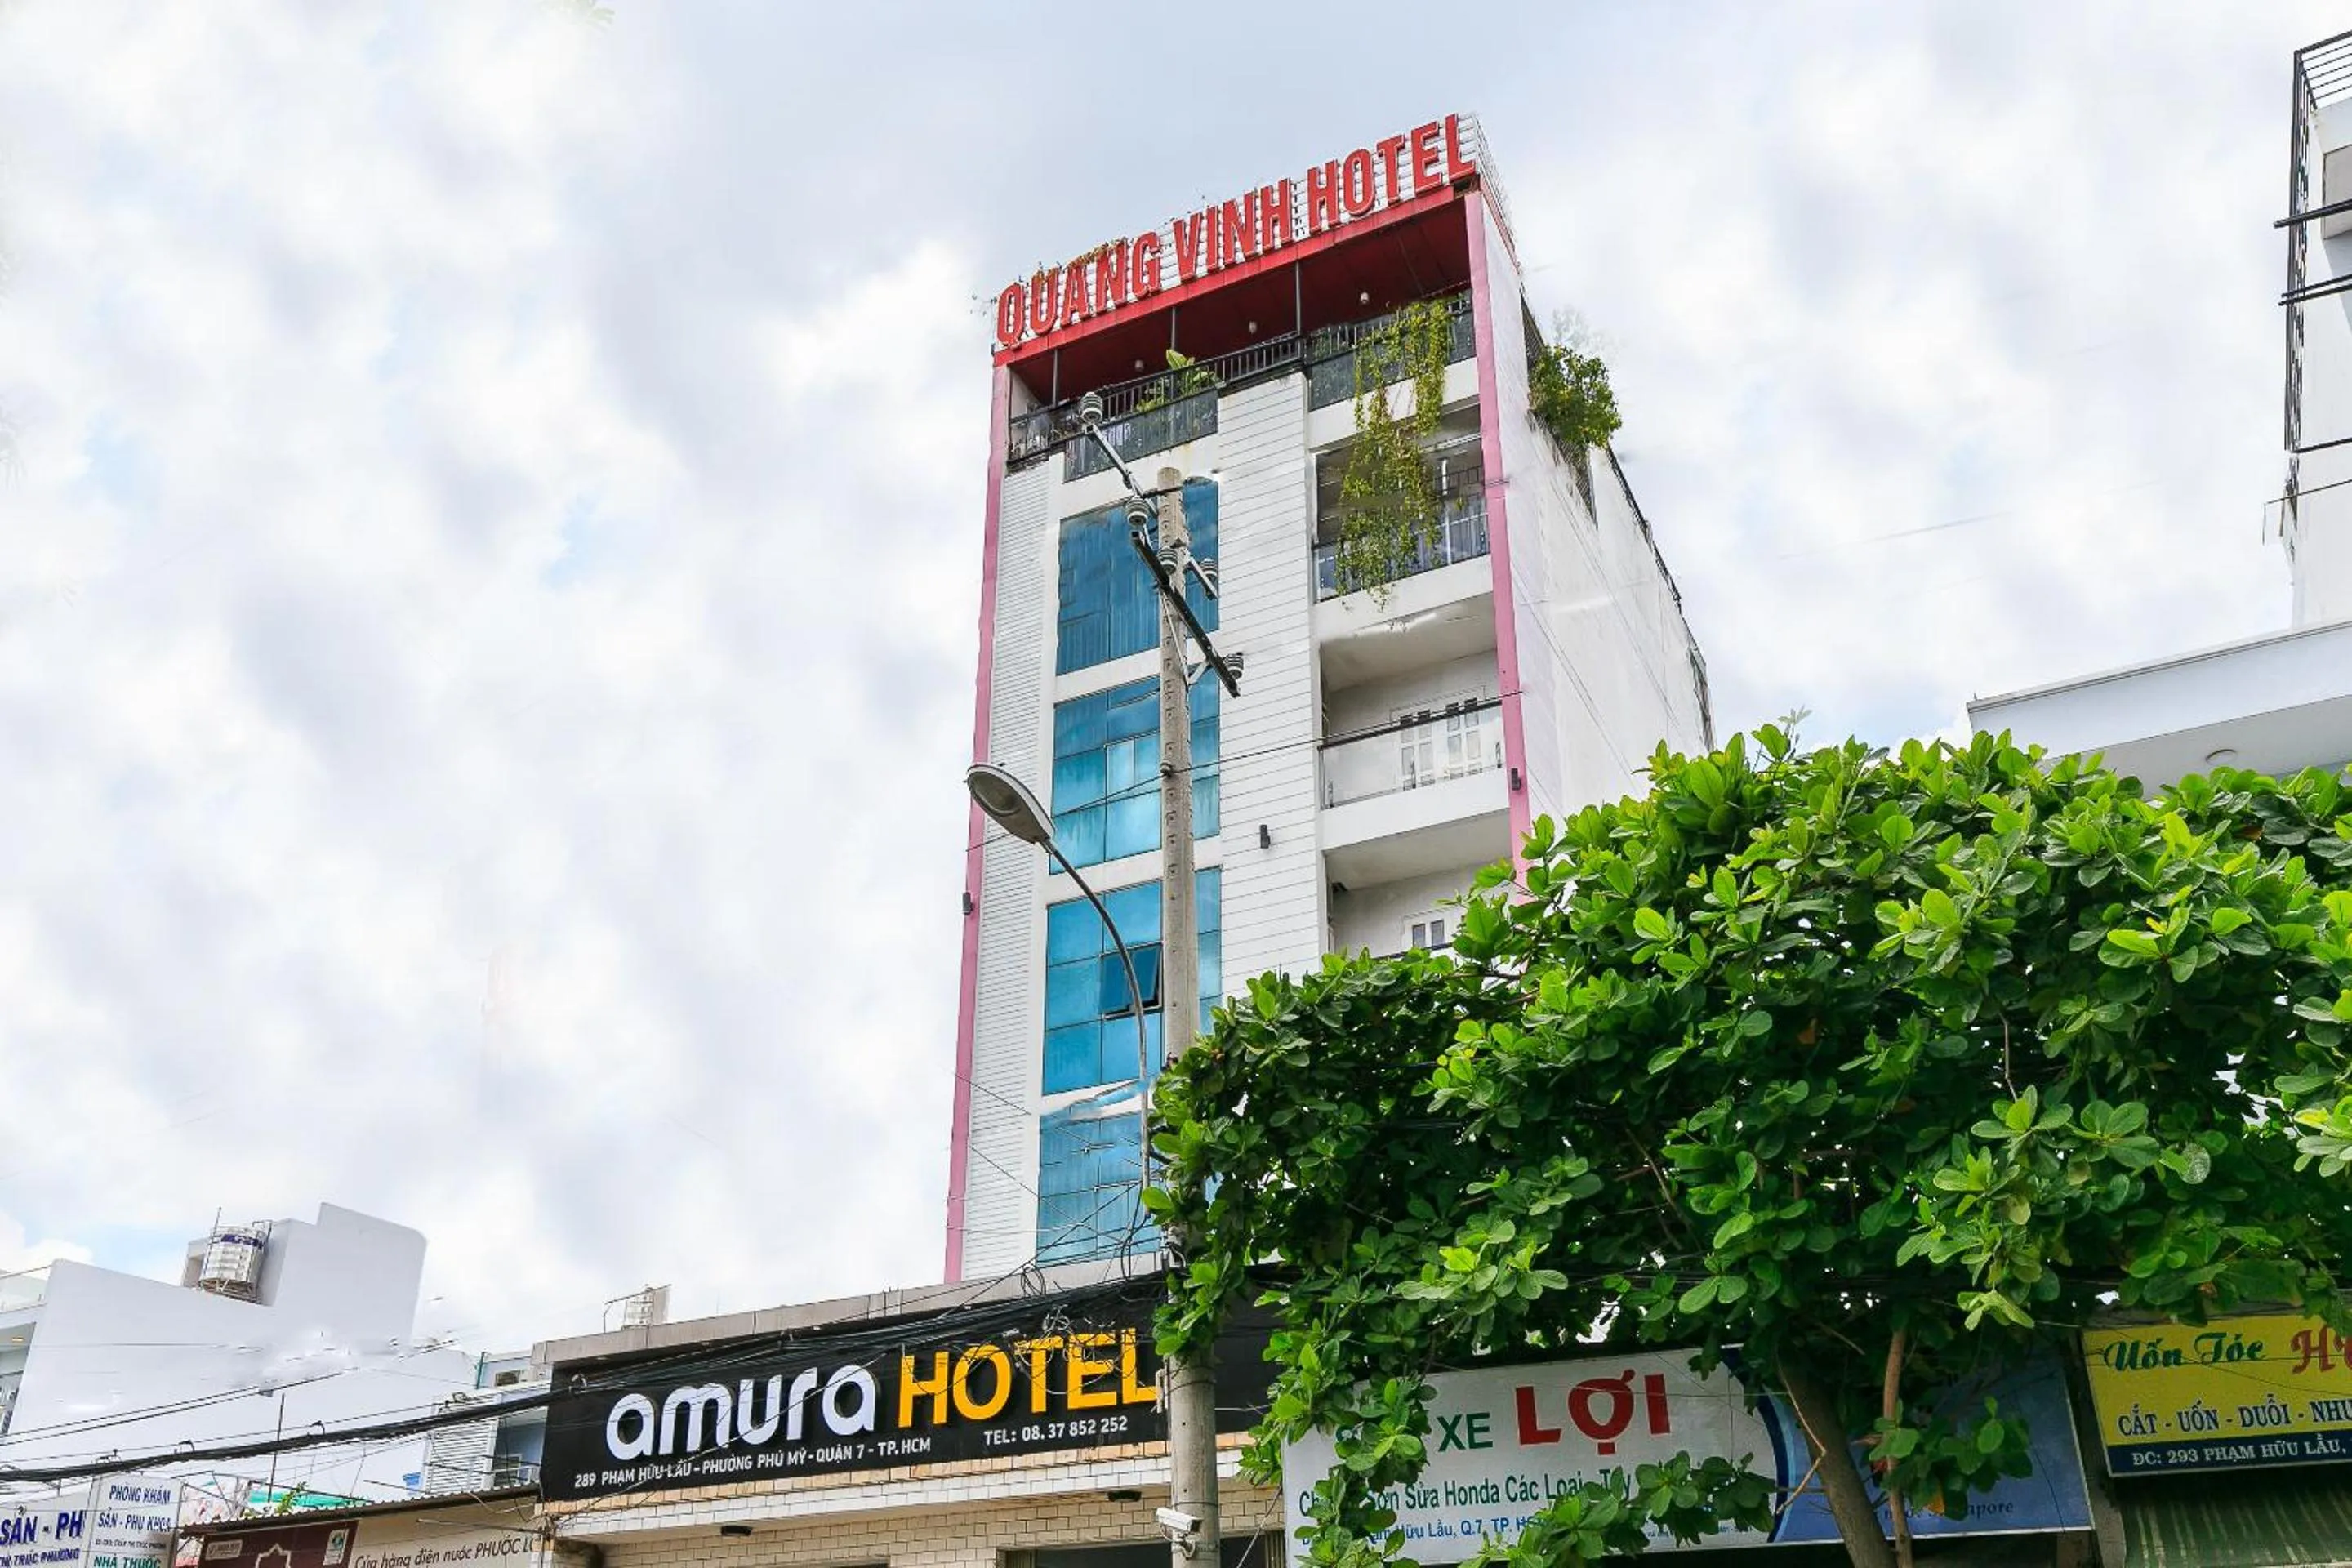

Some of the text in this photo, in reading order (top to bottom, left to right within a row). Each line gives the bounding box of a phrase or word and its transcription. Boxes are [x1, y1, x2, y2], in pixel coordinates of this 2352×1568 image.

[996, 113, 1477, 350] QUANG VINH HOTEL
[2104, 1338, 2182, 1371] Uốn
[2194, 1332, 2266, 1365] Tóc
[607, 1328, 1158, 1460] amura HOTEL
[1437, 1369, 1670, 1455] XE LỢI
[984, 1429, 1017, 1446] TEL:
[1070, 1419, 1096, 1437] 852
[1101, 1415, 1128, 1434] 252
[2118, 1404, 2158, 1437] CẮT
[2176, 1400, 2219, 1432] UỐN
[2238, 1393, 2292, 1428] DUỖI
[575, 1472, 596, 1488] 289
[602, 1468, 635, 1486] PHẠM
[817, 1443, 852, 1463] QUẬN
[857, 1444, 865, 1459] 7
[2132, 1452, 2162, 1465] ĐC:
[2168, 1449, 2198, 1463] 293
[2203, 1445, 2256, 1463] PHẠM
[2261, 1440, 2299, 1458] HỮU
[1405, 1481, 1440, 1509] Sửa
[1444, 1477, 1499, 1507] Honda
[1505, 1473, 1539, 1502] Các
[55, 1510, 87, 1540] PH
